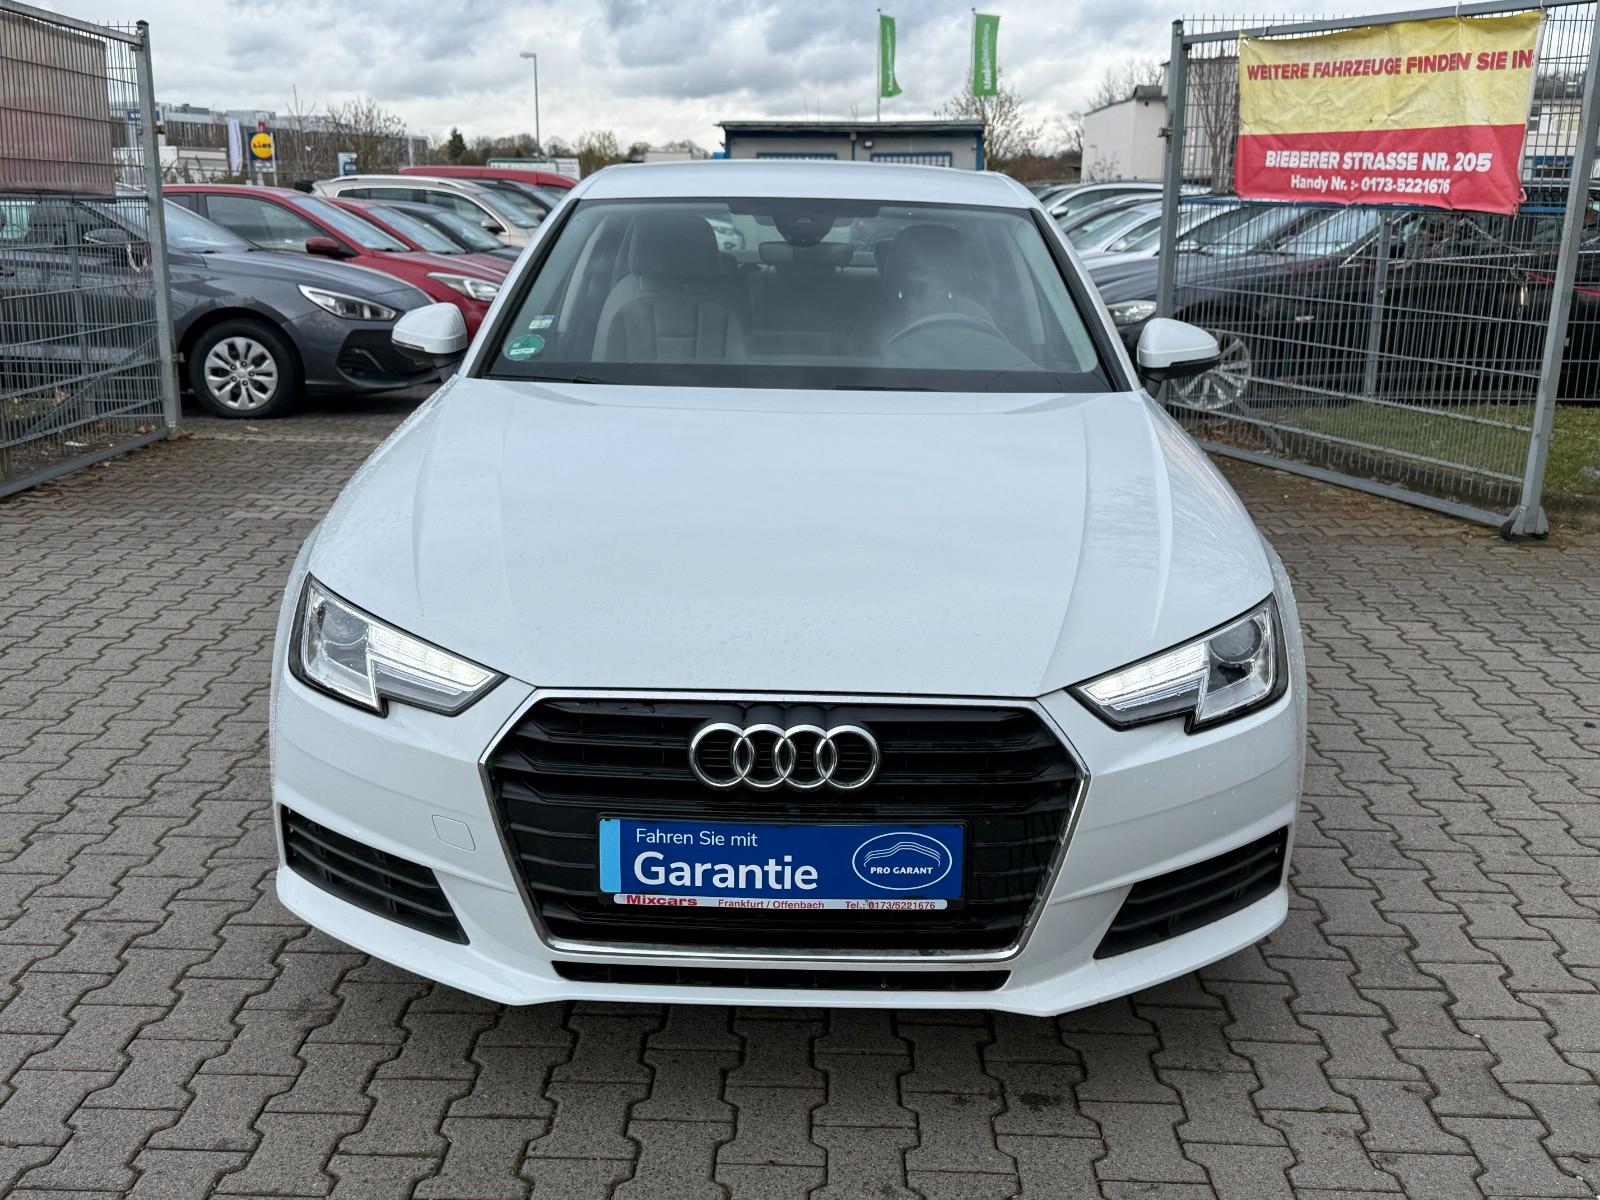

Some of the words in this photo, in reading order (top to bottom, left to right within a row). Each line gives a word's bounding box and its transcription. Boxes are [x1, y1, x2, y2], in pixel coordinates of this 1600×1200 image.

[1247, 63, 1309, 81] WEITERE
[1312, 57, 1402, 78] FAHRZEUGE
[1406, 52, 1472, 74] FINDEN
[1475, 51, 1508, 71] SIE
[1265, 150, 1338, 169] BIEBERER
[1342, 151, 1417, 171] STRASSE
[1421, 152, 1451, 172] NR.
[1453, 152, 1493, 173] 205
[1290, 174, 1328, 193] Handy
[1330, 176, 1348, 191] Nr.
[1361, 178, 1451, 194] 0173-5221676
[636, 828, 694, 845] Fahren
[699, 831, 725, 846] Sie
[731, 832, 759, 847] mit
[633, 851, 819, 890] Garantie
[870, 866, 890, 875] PRO
[893, 866, 933, 875] GARANT
[626, 894, 698, 906] Mixcars
[718, 899, 764, 909] Frankfurt
[772, 901, 825, 910] Offenbach
[845, 901, 866, 910] Tel.:
[868, 902, 936, 911] 0173/5221676
